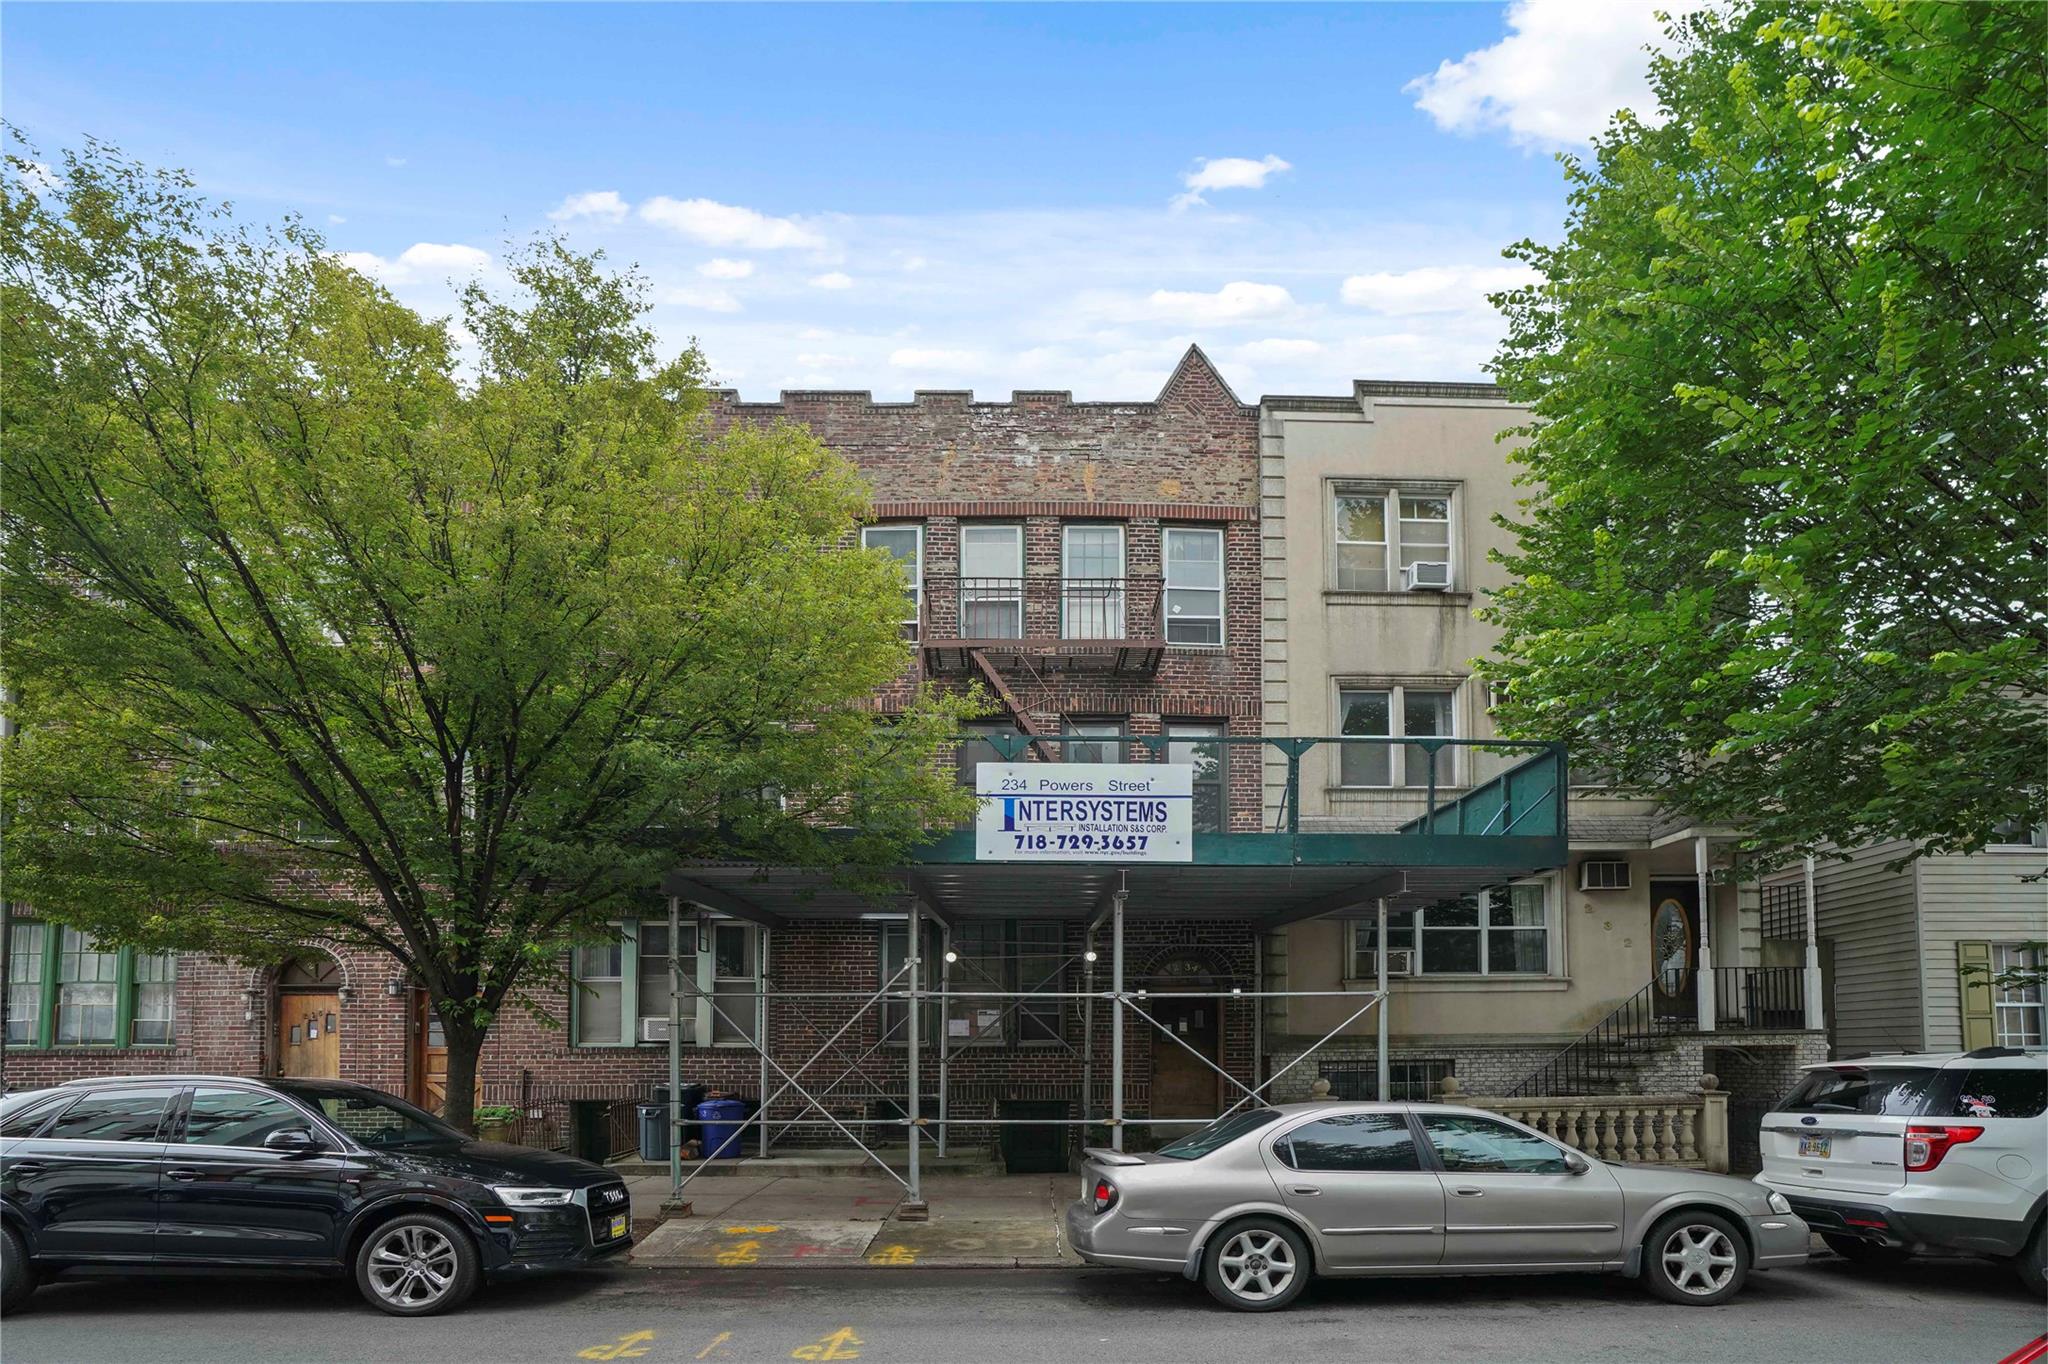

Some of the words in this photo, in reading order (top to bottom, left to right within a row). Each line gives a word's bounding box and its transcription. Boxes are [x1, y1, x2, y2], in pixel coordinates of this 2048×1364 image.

[1001, 779, 1027, 791] 234
[1039, 779, 1093, 791] Powers
[1108, 780, 1151, 792] Street
[997, 797, 1167, 832] INTERSYSTEMS
[1078, 823, 1129, 833] INSTALLATION
[1130, 824, 1145, 833] S&S
[1146, 824, 1167, 833] CORP.
[1014, 835, 1149, 850] 718-729-3657
